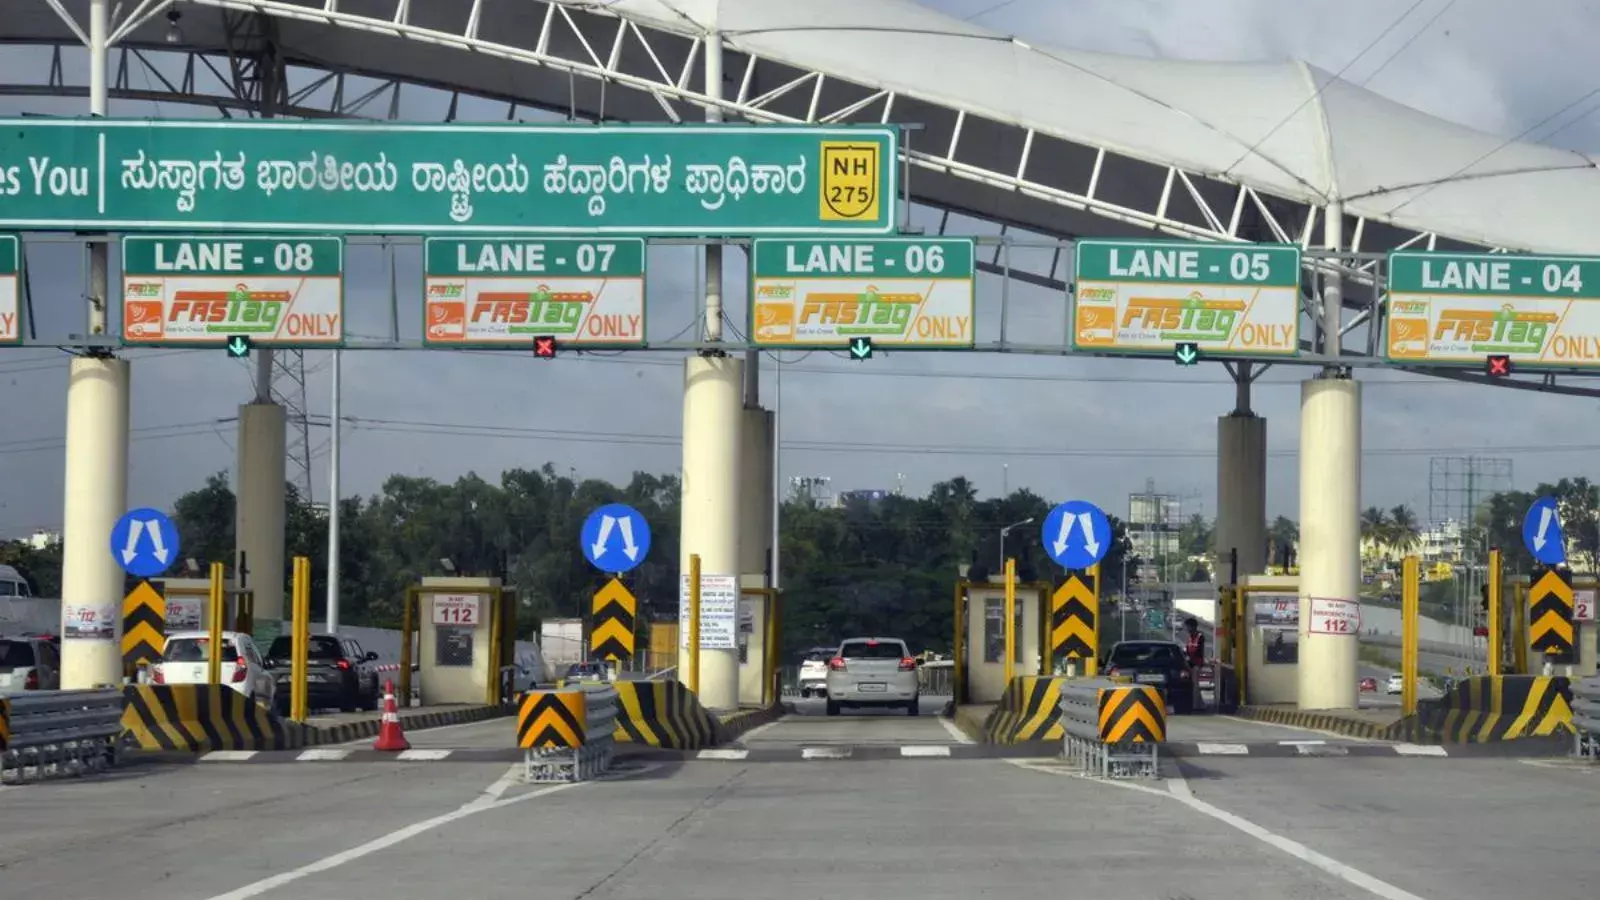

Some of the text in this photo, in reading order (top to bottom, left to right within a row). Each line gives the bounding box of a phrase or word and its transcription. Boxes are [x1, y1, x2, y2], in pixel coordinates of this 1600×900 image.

[29, 156, 88, 196] You
[834, 157, 867, 176] NH
[121, 149, 807, 222] ಸುಸ್ವಾಗತ ಭಾರತೀಯ ರಾಷ್ಟ್ರೀಯ ಹೆದ್ದಾರಿಗಳ ಪ್ರಾಧಿಕಾರ
[831, 186, 868, 203] 275
[155, 243, 243, 271] LANE
[274, 243, 314, 271] 08
[457, 244, 545, 272] LANE
[576, 244, 616, 272] 07
[786, 245, 875, 273] LANE
[905, 245, 945, 274] 06
[1109, 249, 1198, 279] LANE
[1230, 251, 1271, 282] 05
[1421, 260, 1511, 290] LANE
[1542, 264, 1583, 293] 04
[287, 313, 338, 336] ONLY
[588, 314, 640, 337] ONLY
[916, 315, 969, 339] ONLY
[1241, 322, 1293, 347] ONLY
[441, 608, 472, 622] 112
[1324, 619, 1347, 631] 112
